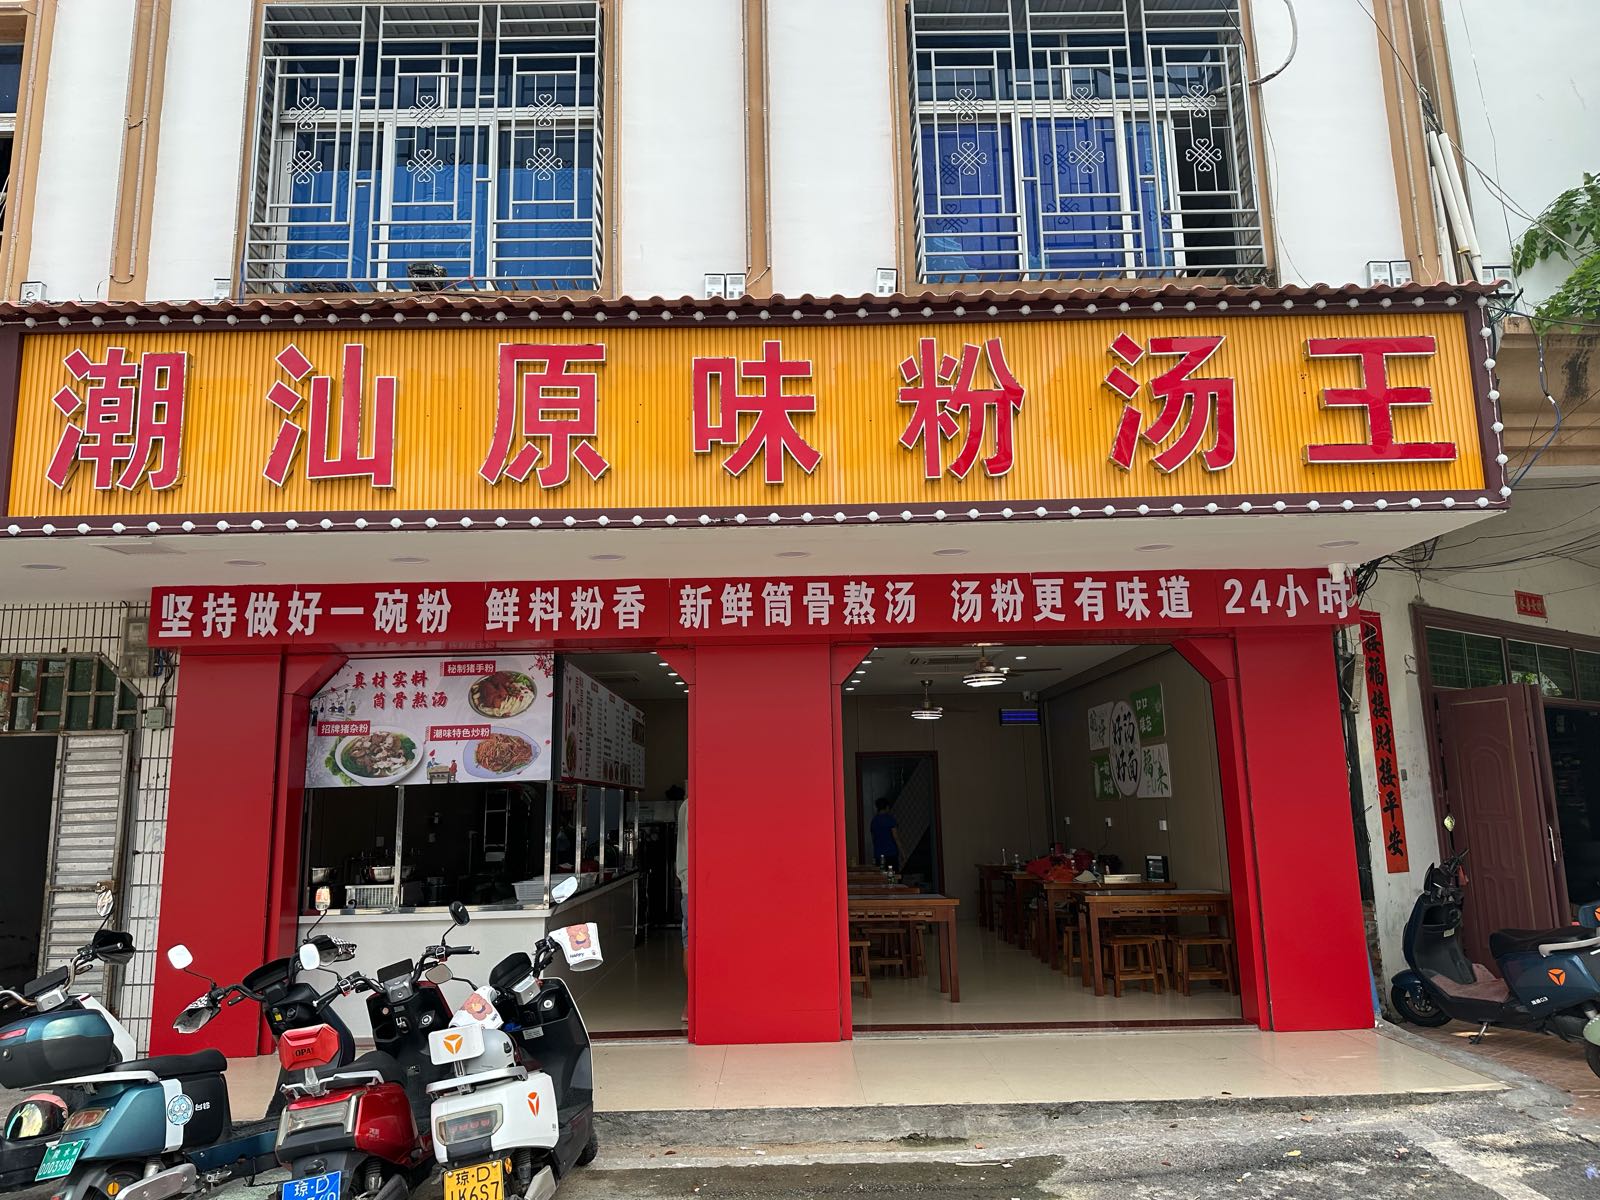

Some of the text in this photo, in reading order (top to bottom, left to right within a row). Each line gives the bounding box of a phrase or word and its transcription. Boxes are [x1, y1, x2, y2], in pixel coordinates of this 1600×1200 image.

[45, 331, 1458, 492] 潮汕原味粉汤王
[158, 574, 1351, 638] 坚持做好一碗粉 鲜料粉香 新鲜筒骨熬汤 汤粉更有味道 24小时
[447, 663, 494, 675] 秘制猪手粉
[352, 670, 429, 689] 真材实料
[372, 691, 449, 710] 筒骨熬汤
[321, 724, 369, 735] 招牌猪杂粉
[433, 728, 491, 739] 潮味特色炒粉
